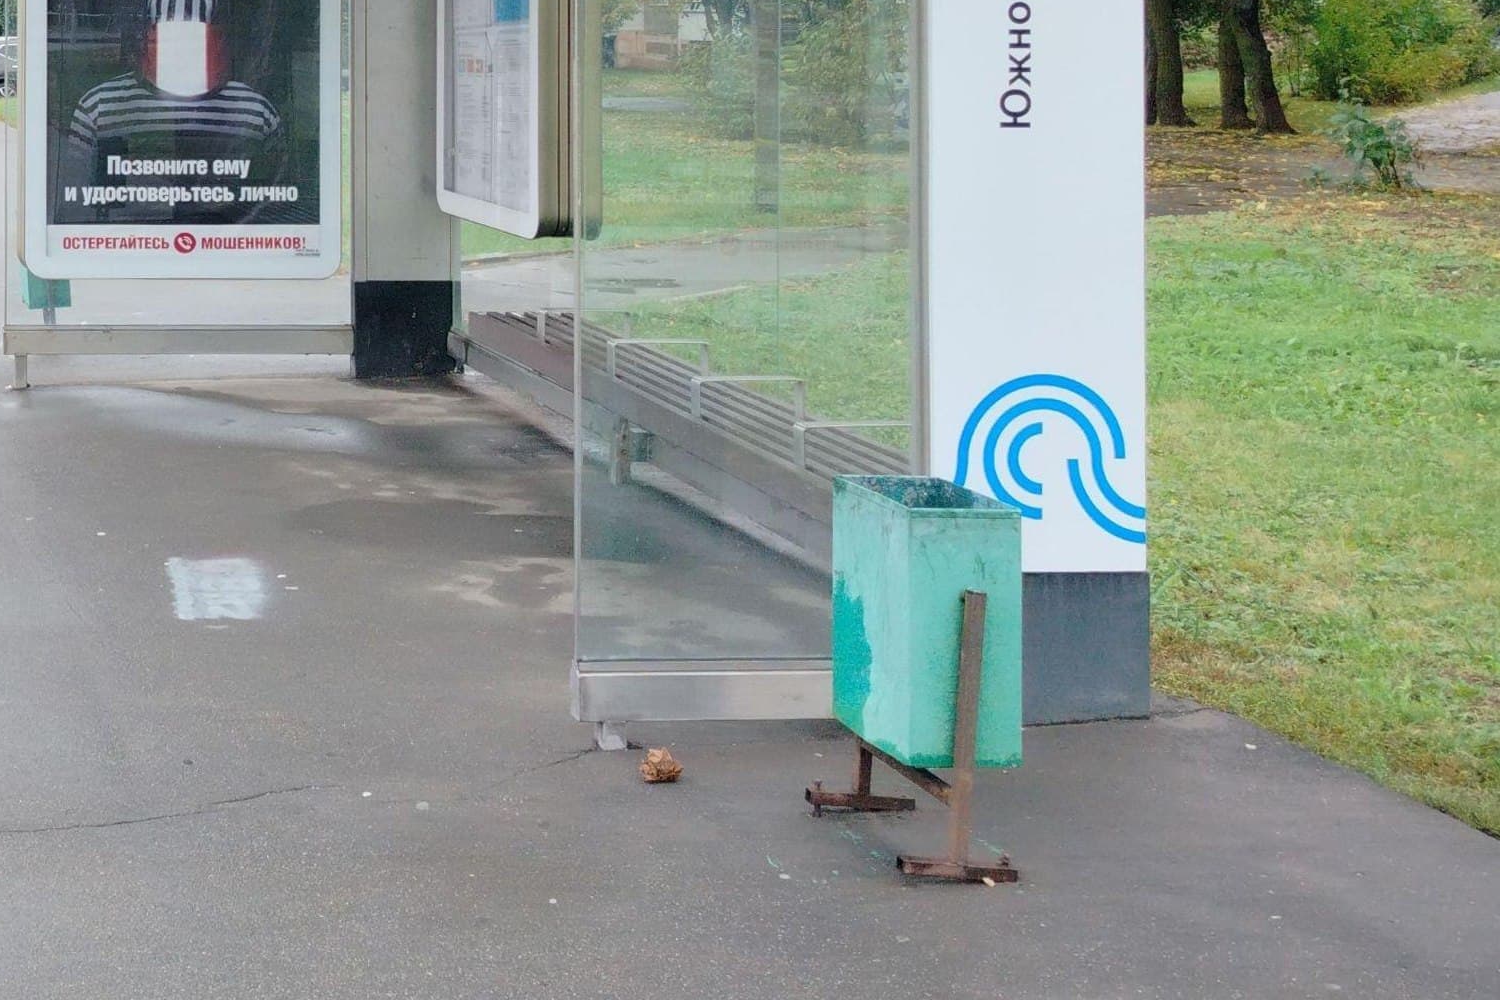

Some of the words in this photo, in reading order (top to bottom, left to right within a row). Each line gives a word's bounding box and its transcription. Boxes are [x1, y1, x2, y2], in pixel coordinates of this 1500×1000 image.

[107, 155, 208, 175] Позвоните
[213, 159, 251, 179] ему
[64, 186, 77, 202] и
[81, 186, 235, 207] удостоверьтесь
[238, 186, 299, 202] лично
[63, 234, 170, 250] ОСТЕРЕГАЙТЕСЬ
[201, 236, 306, 250] МОШЕННИКОВ!
